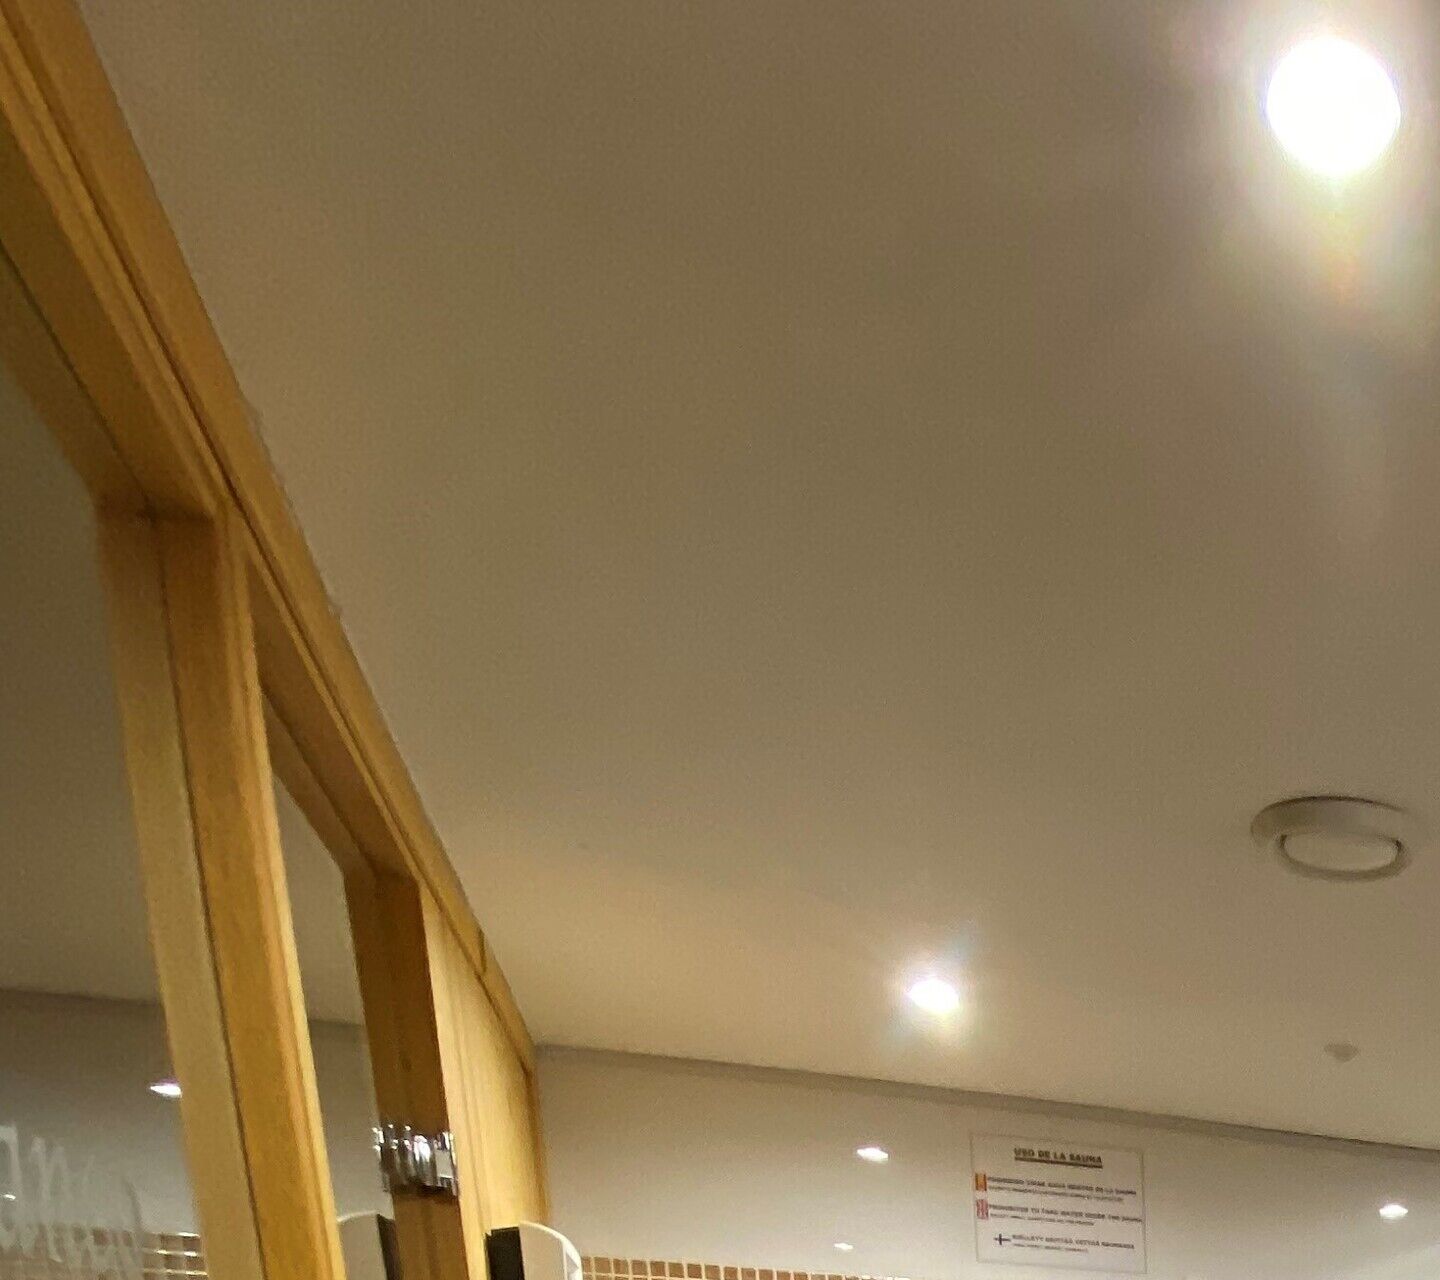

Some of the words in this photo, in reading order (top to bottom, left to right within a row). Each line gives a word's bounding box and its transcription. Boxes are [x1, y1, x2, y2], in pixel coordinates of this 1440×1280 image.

[1014, 1147, 1035, 1157] USO
[1038, 1150, 1051, 1158] DE
[1053, 1152, 1067, 1161] LA
